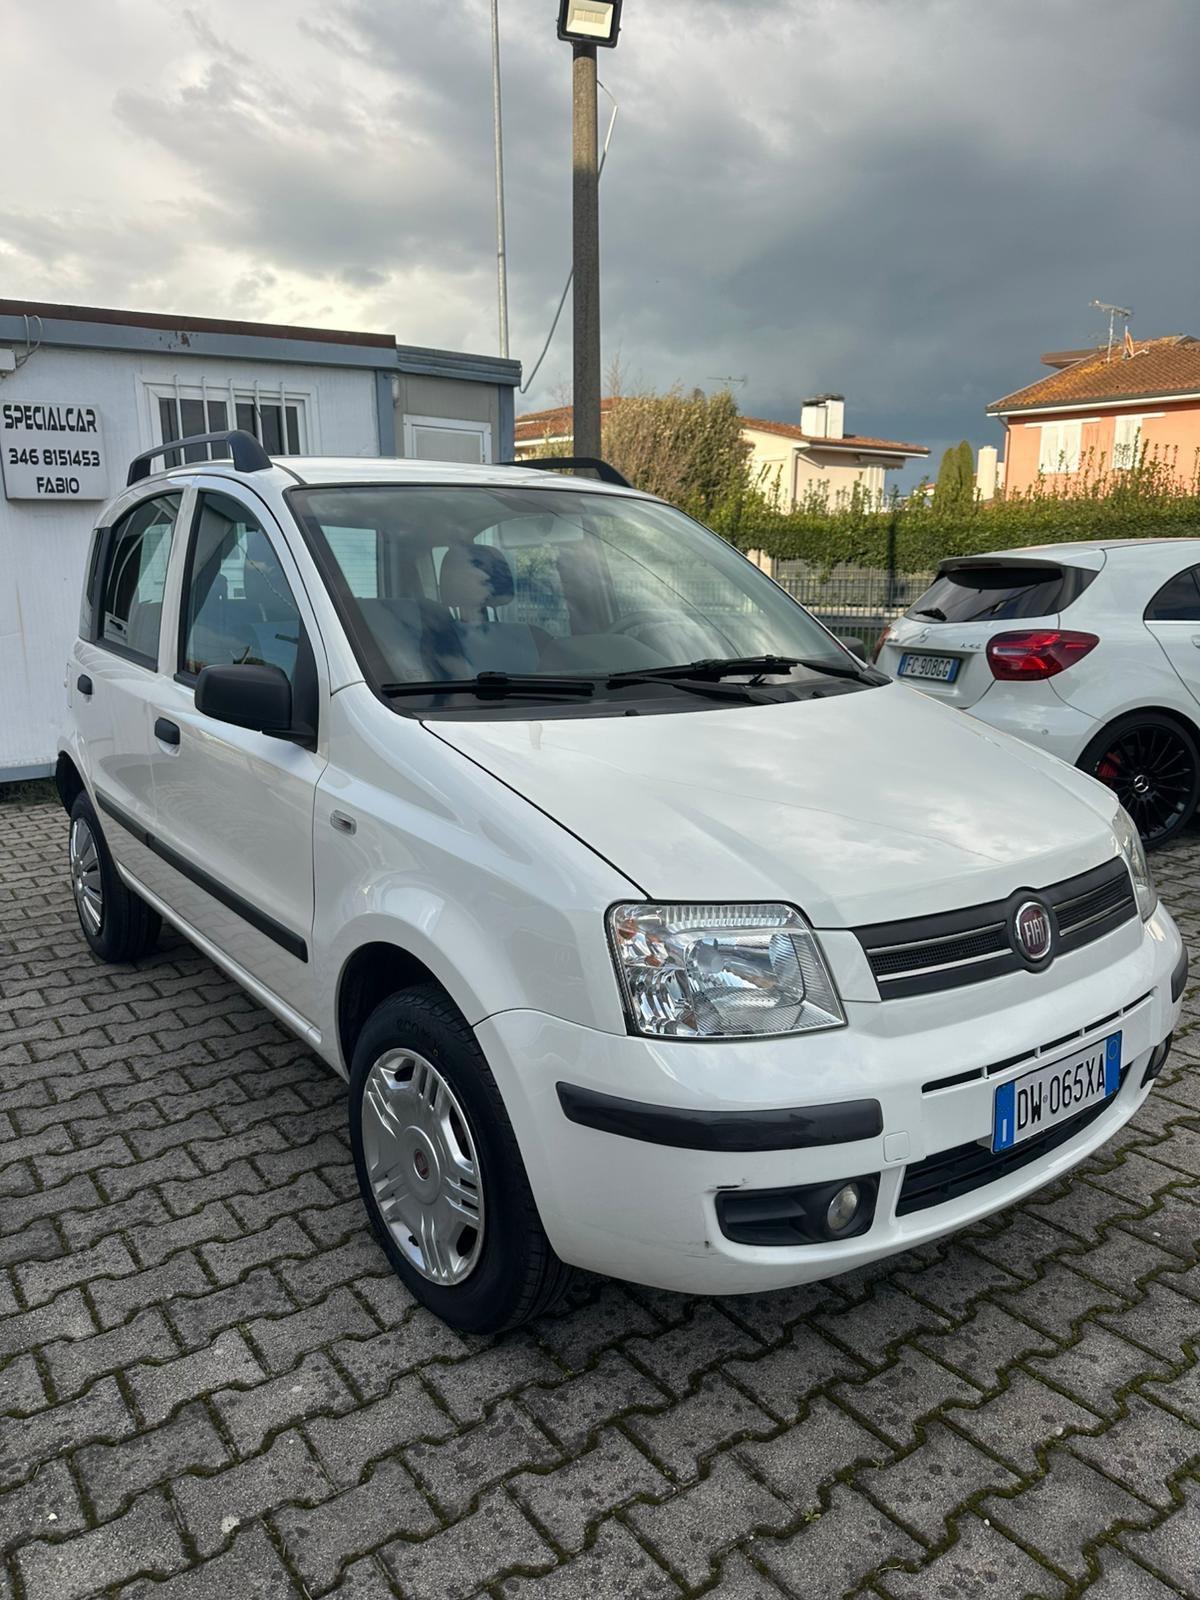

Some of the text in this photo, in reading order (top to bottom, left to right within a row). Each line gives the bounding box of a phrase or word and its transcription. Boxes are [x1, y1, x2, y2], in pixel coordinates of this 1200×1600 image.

[3, 404, 97, 432] SPECIALCAR
[9, 448, 100, 467] 346 8151453
[36, 476, 80, 494] FABIO
[904, 656, 951, 678] FC 908GG
[1023, 916, 1046, 947] FIAT
[1017, 1053, 1106, 1131] DW 065XA
